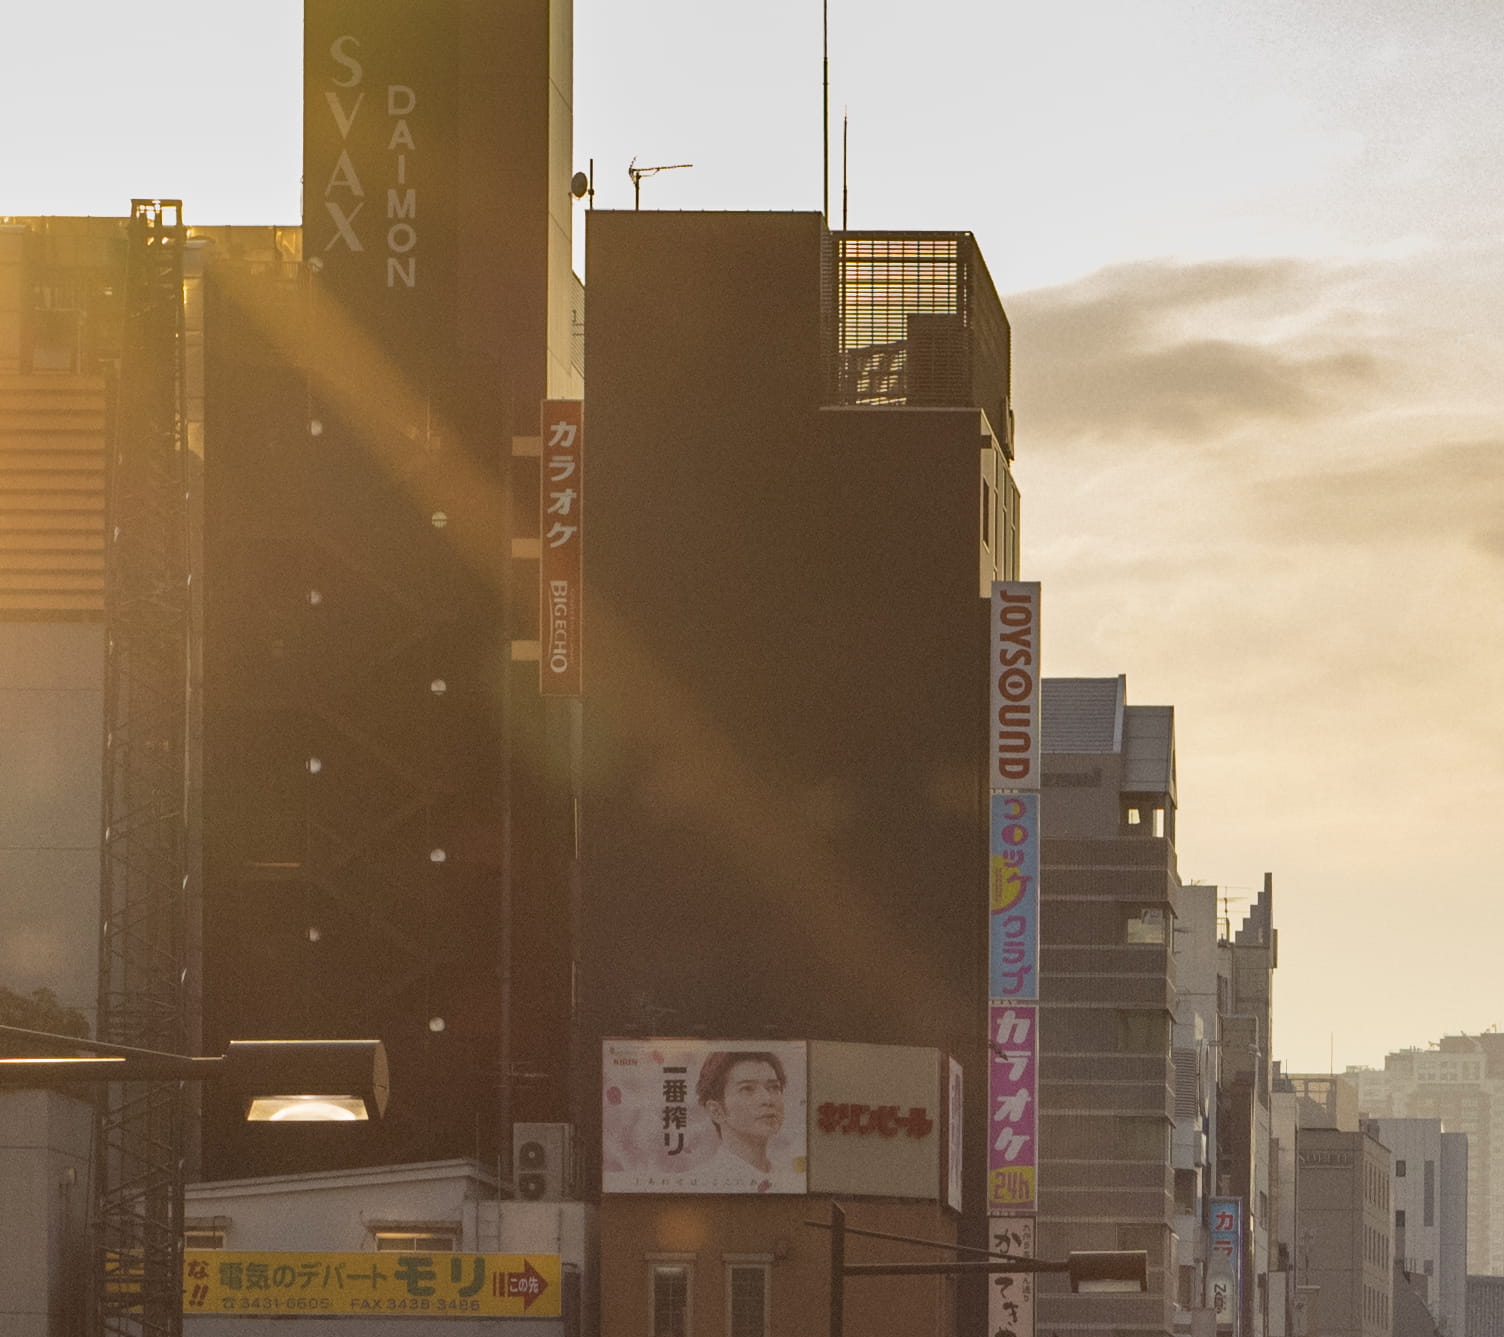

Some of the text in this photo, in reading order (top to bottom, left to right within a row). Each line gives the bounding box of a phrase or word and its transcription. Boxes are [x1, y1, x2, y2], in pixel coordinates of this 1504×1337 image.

[324, 34, 364, 252] SVAX
[386, 86, 416, 288] DAIMON
[547, 420, 577, 549] カラオケ
[998, 590, 1032, 779] JOYSOUND
[662, 1066, 688, 1156] 一番搾り
[994, 1010, 1032, 1161] カラオケ
[219, 1256, 485, 1297] 電気のデパート モリ
[351, 1299, 382, 1310] FAX
[509, 1278, 539, 1294] この先
